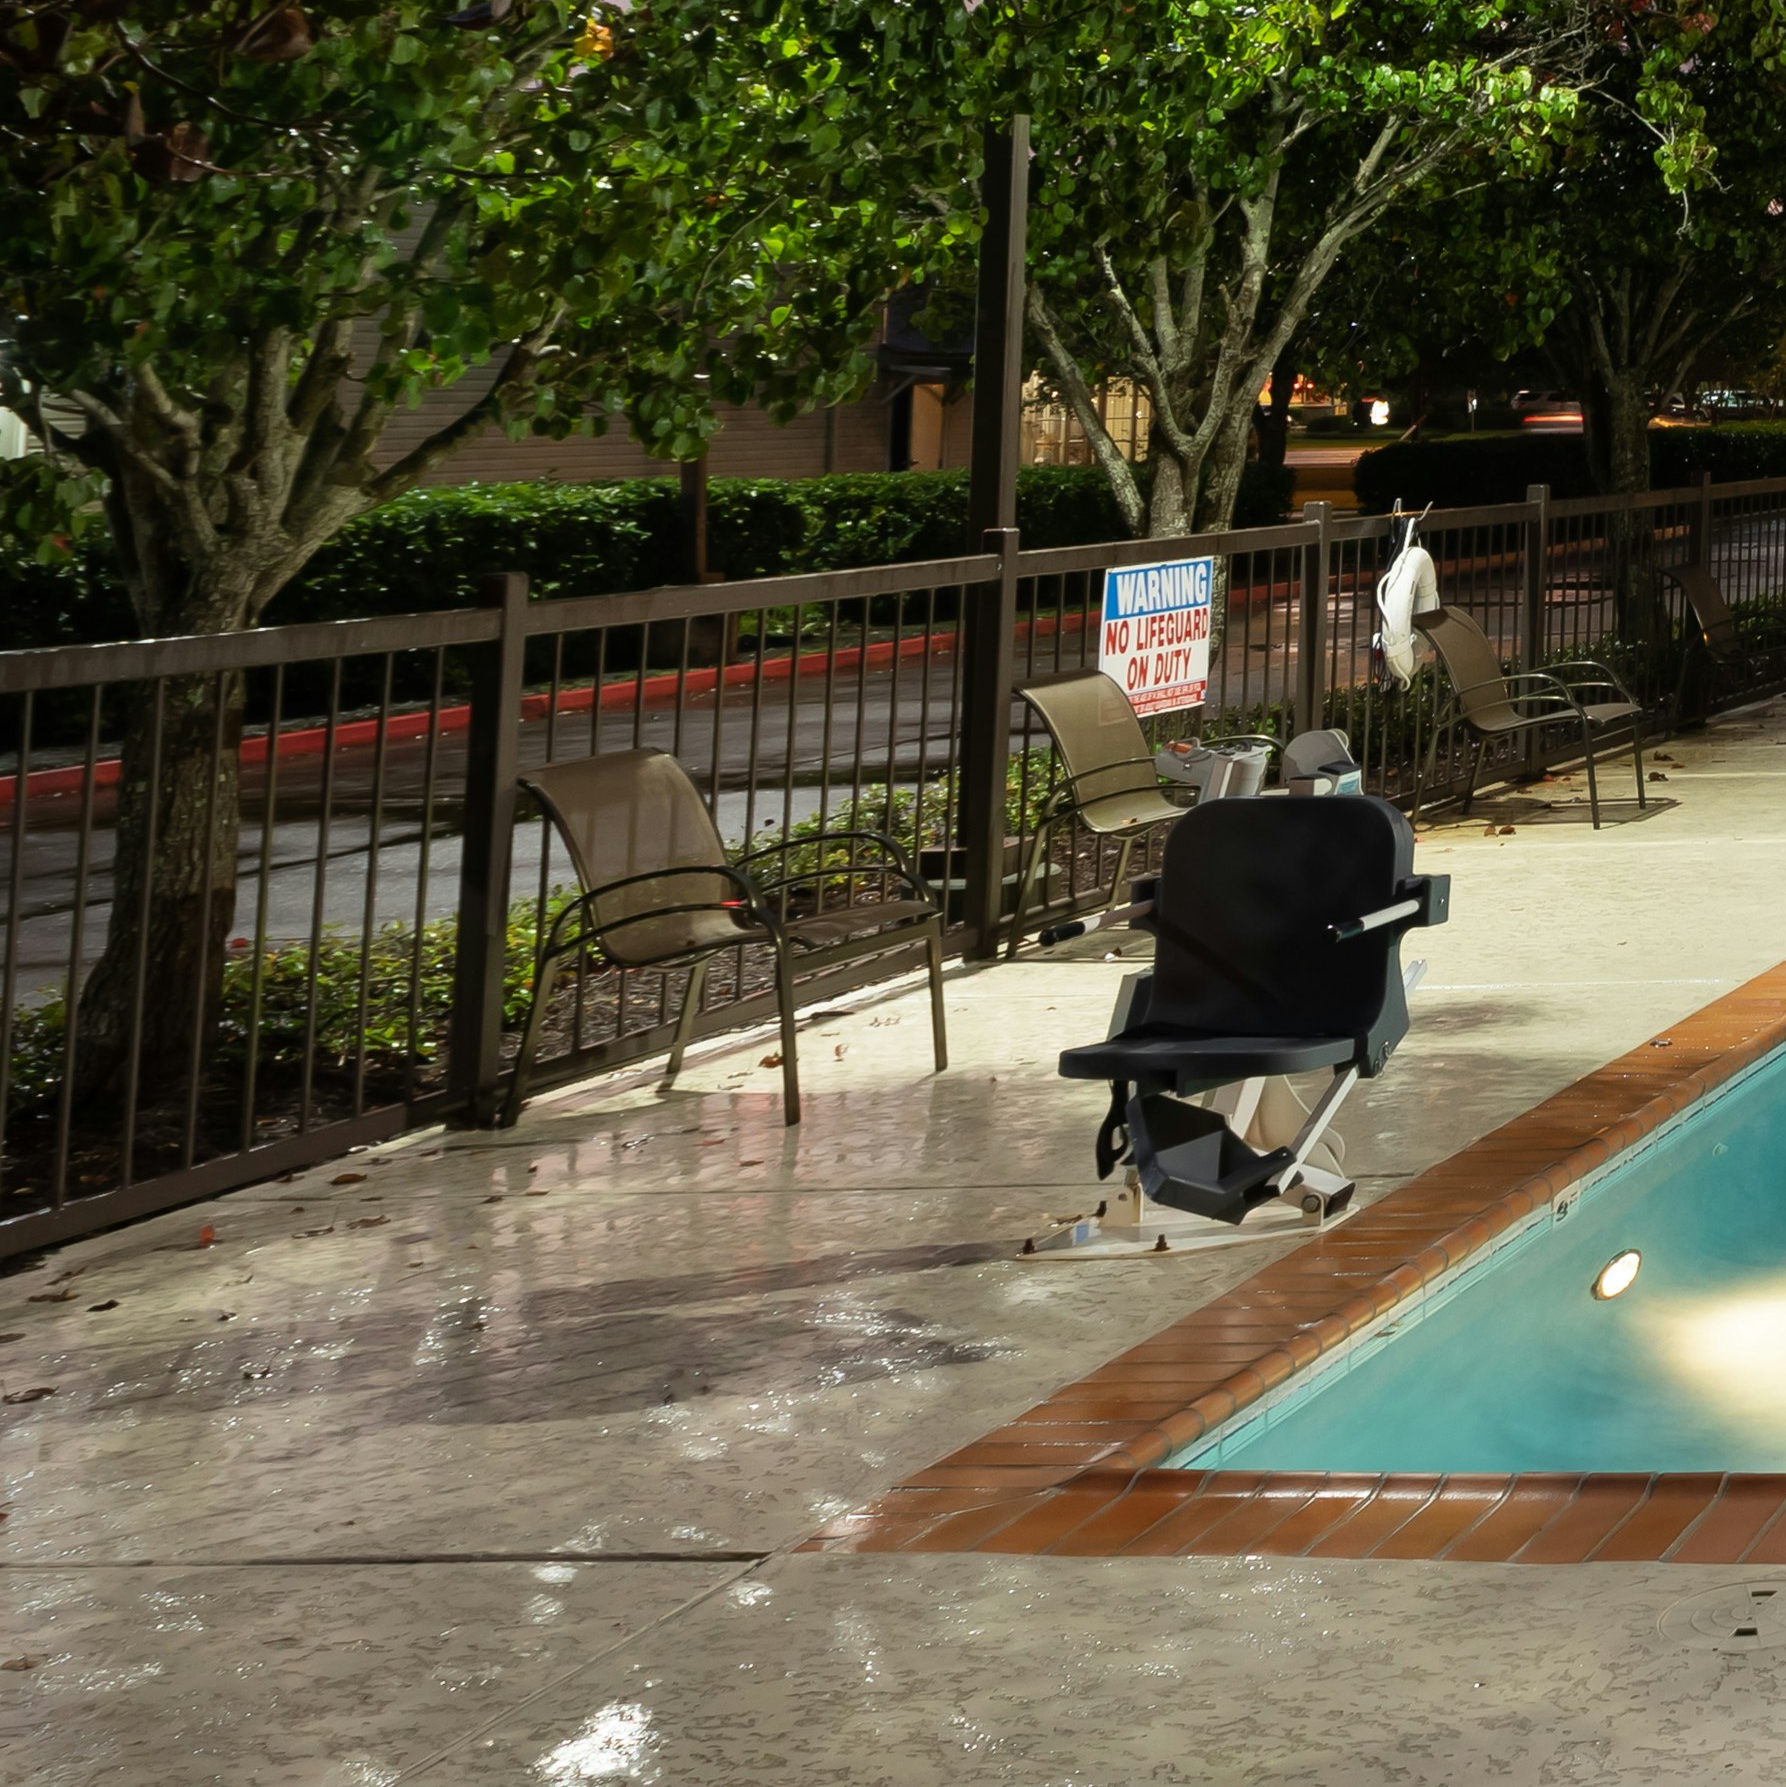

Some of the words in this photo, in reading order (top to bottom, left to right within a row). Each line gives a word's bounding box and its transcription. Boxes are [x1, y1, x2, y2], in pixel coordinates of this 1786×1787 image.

[1116, 563, 1207, 616] WARNING
[1105, 620, 1130, 655] NO
[1136, 607, 1209, 651] LIFEGUARD
[1127, 656, 1149, 691] ON
[1153, 647, 1192, 686] DUTY
